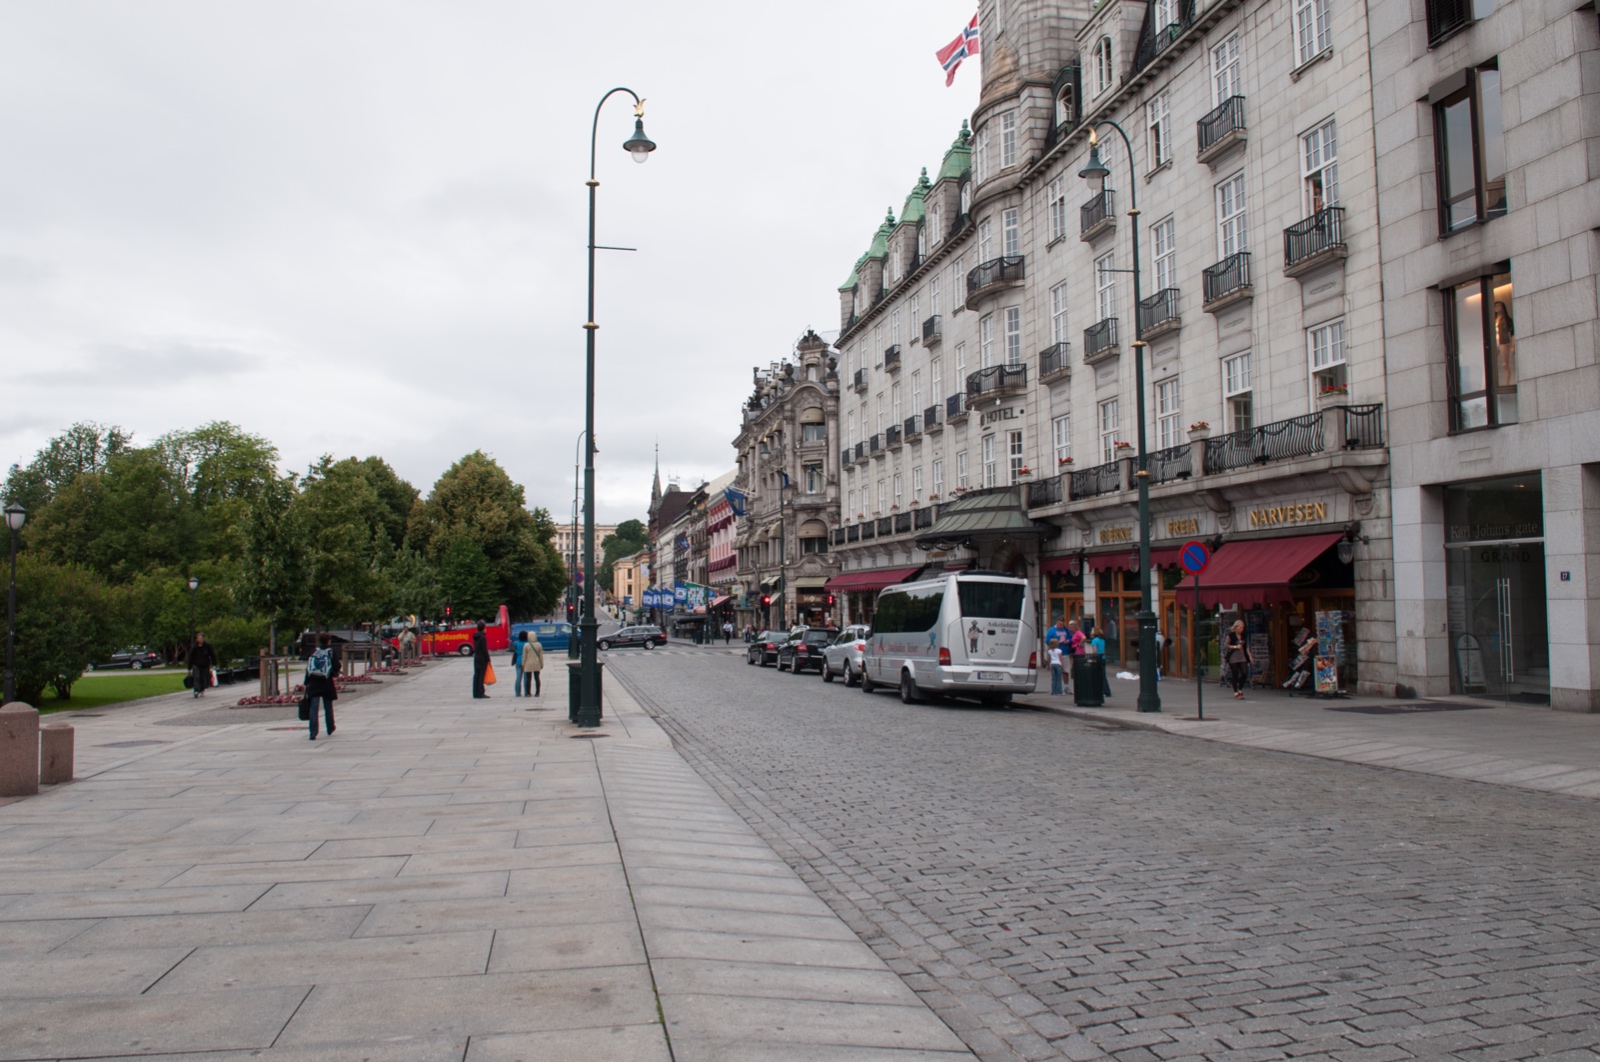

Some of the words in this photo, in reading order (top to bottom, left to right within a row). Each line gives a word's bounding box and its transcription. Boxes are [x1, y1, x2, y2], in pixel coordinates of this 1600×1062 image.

[986, 407, 1019, 424] HOTEL
[1249, 501, 1327, 526] NARVESEN
[1167, 518, 1200, 535] FREIA
[1451, 525, 1471, 539] Karl
[1474, 523, 1511, 539] Johans
[1515, 522, 1538, 537] gate
[1480, 550, 1531, 563] GRAND
